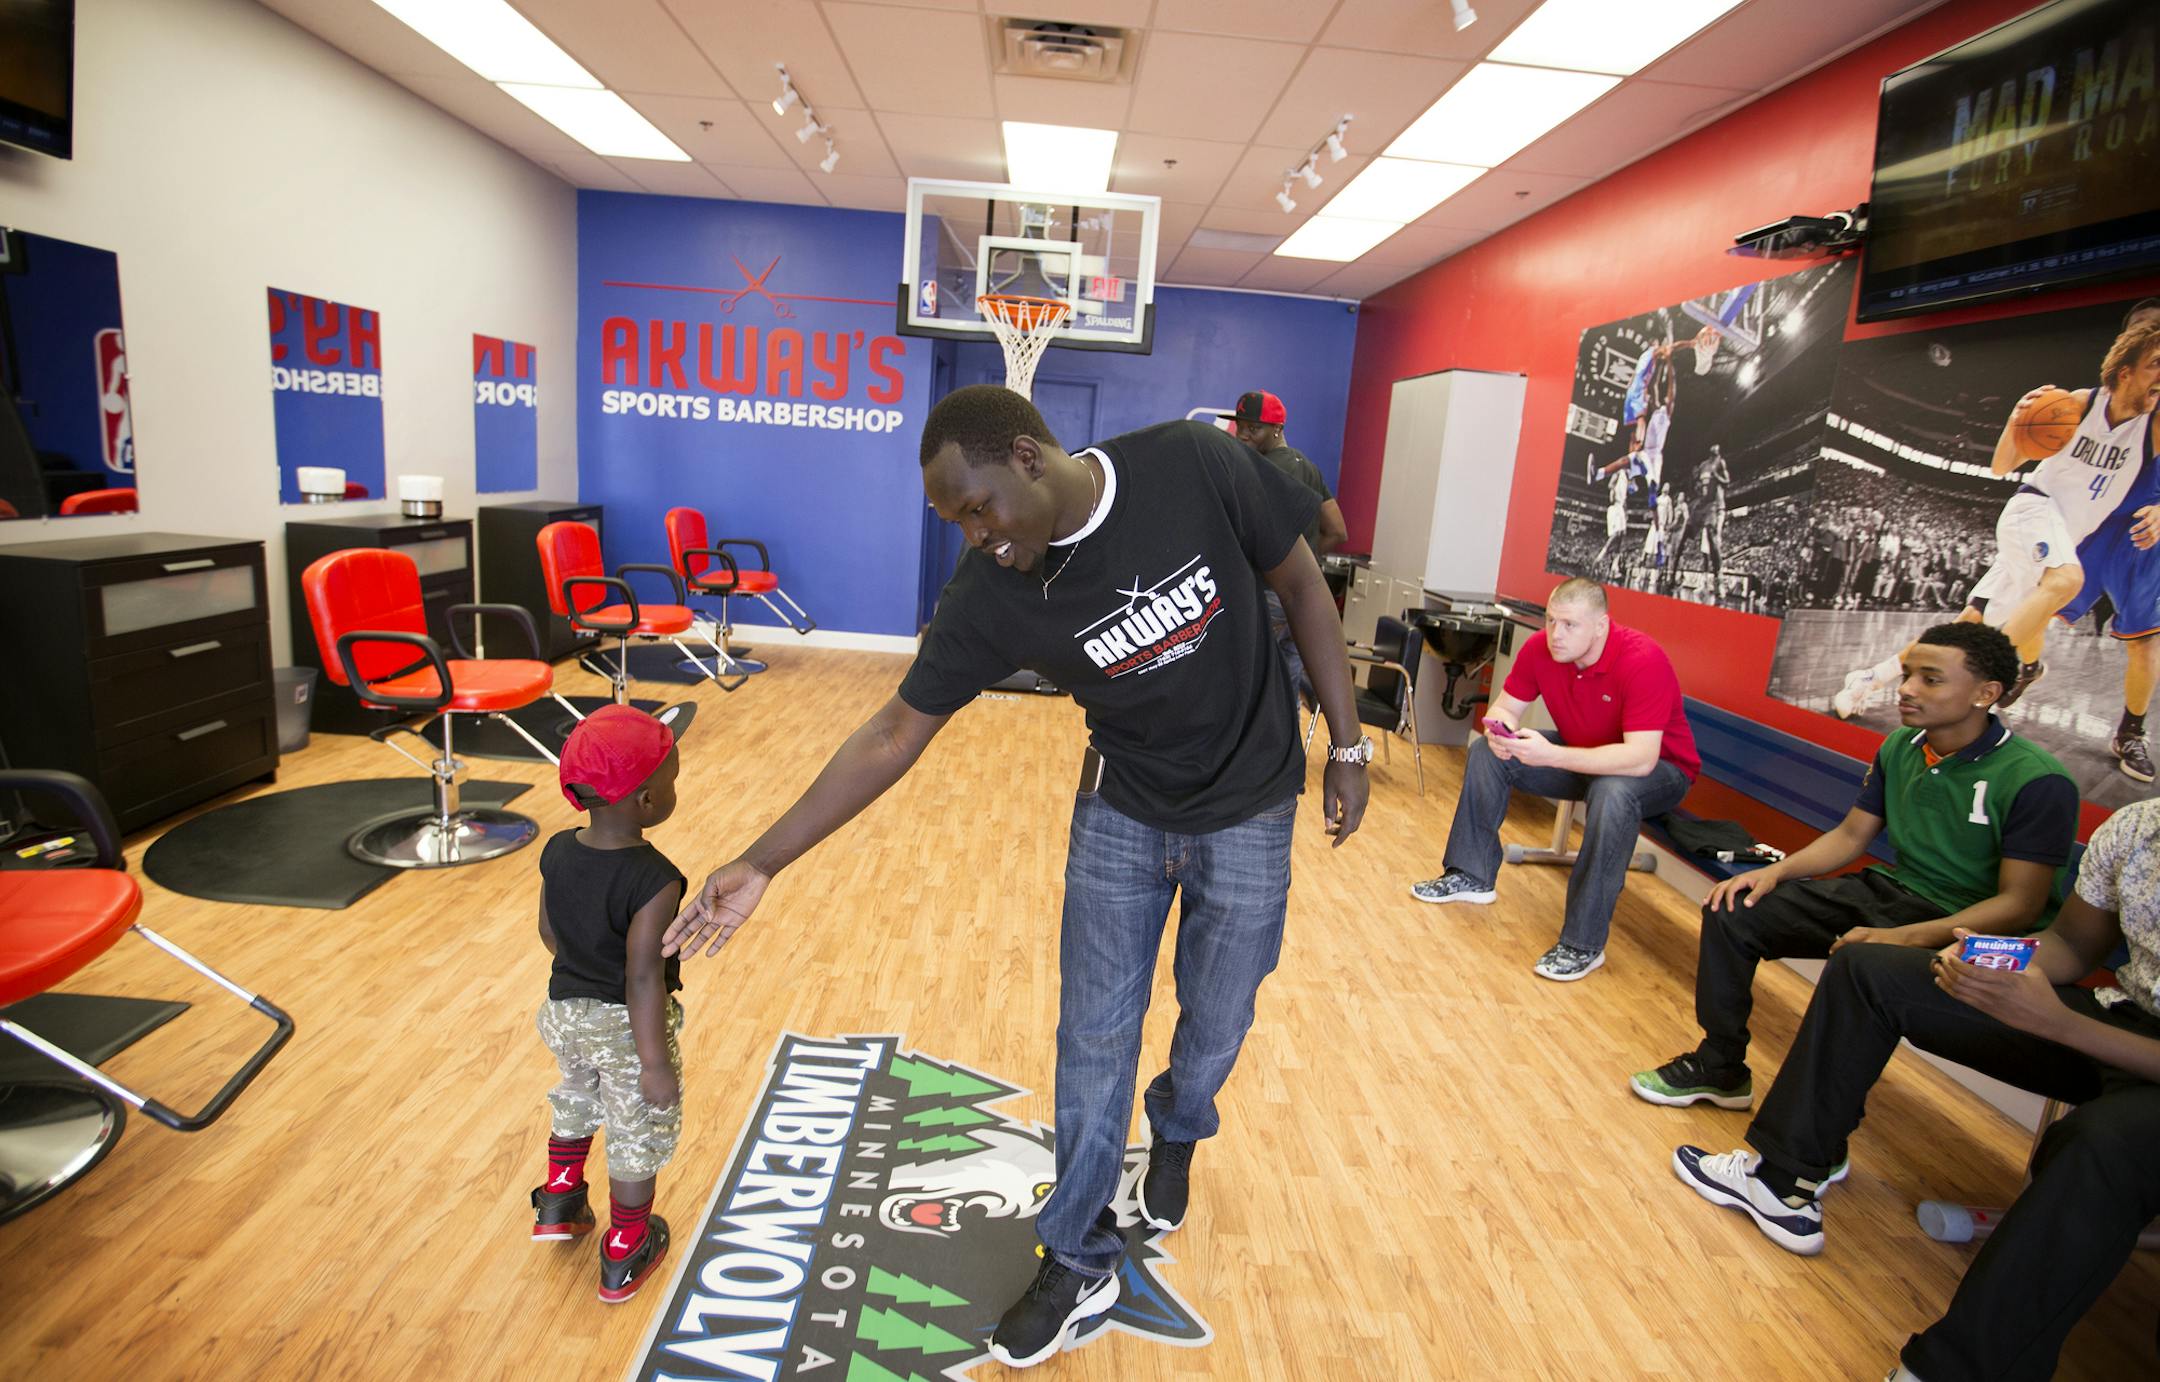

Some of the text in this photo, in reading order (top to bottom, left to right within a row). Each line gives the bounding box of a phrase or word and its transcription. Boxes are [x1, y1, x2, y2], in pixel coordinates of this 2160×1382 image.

[1951, 66, 2056, 163] MAD
[1946, 139, 2041, 198] FURY
[1084, 314, 1132, 330] SPALDING
[602, 317, 906, 404] AKWAY'S
[602, 390, 904, 433] SPORTS BARBERSHOP
[2070, 436, 2130, 470] DALLAS
[2089, 474, 2116, 501] 41
[1083, 566, 1217, 669] AKWAY'S
[1104, 649, 1153, 677] SPORTS
[1968, 780, 1990, 826] 1
[796, 1094, 897, 1374] MINNESOTA
